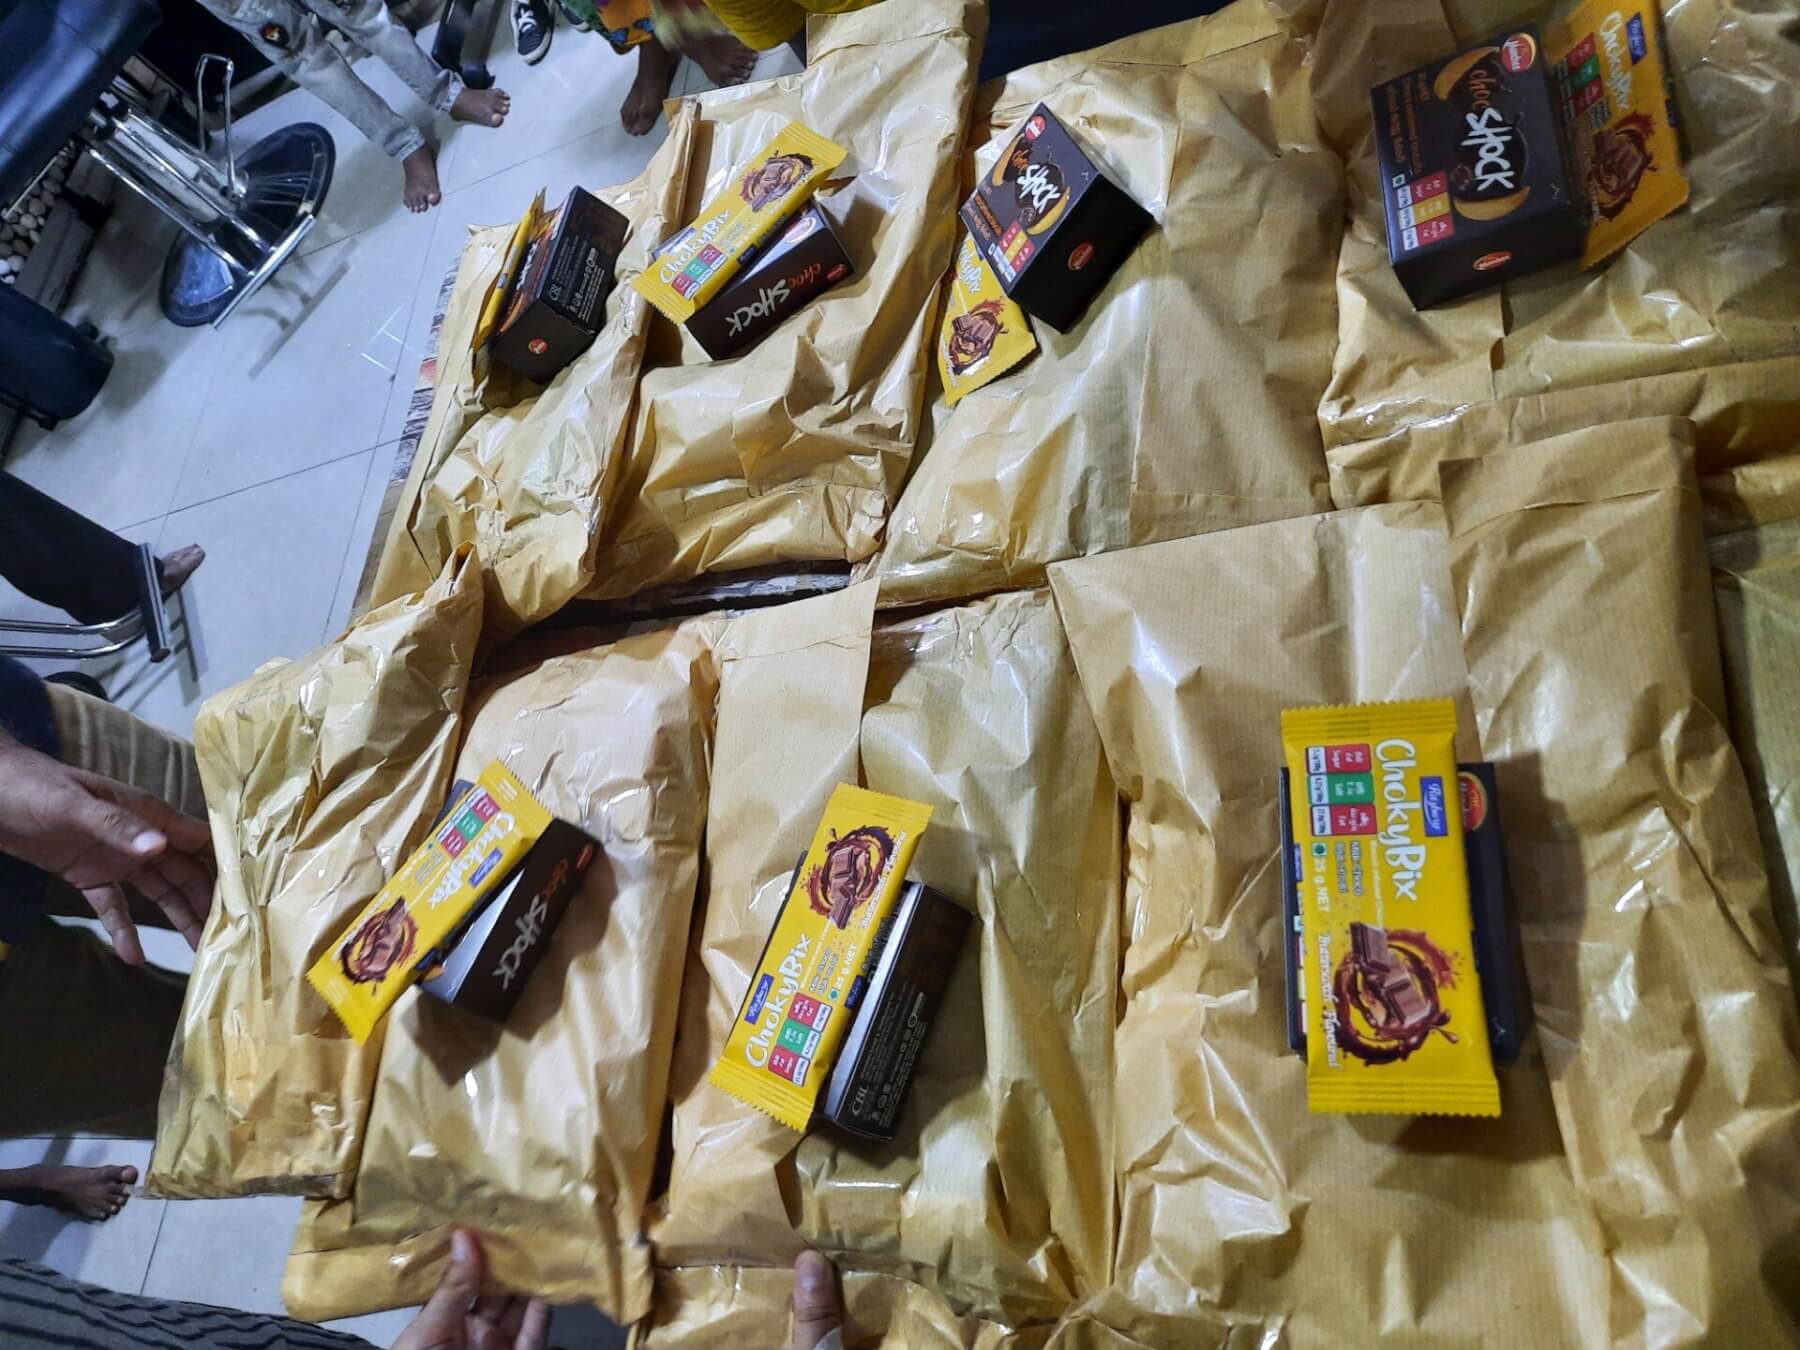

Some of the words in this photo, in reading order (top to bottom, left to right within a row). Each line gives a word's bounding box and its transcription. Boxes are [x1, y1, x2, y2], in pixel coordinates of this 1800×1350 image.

[1017, 164, 1061, 214] SHOCK
[1461, 107, 1515, 192] SHOCK
[725, 279, 791, 337] SHOCK
[1375, 738, 1427, 901] ChokyBix
[492, 895, 548, 990] SHOCK
[1317, 888, 1331, 912] NET
[746, 934, 812, 1068] ChokyBix
